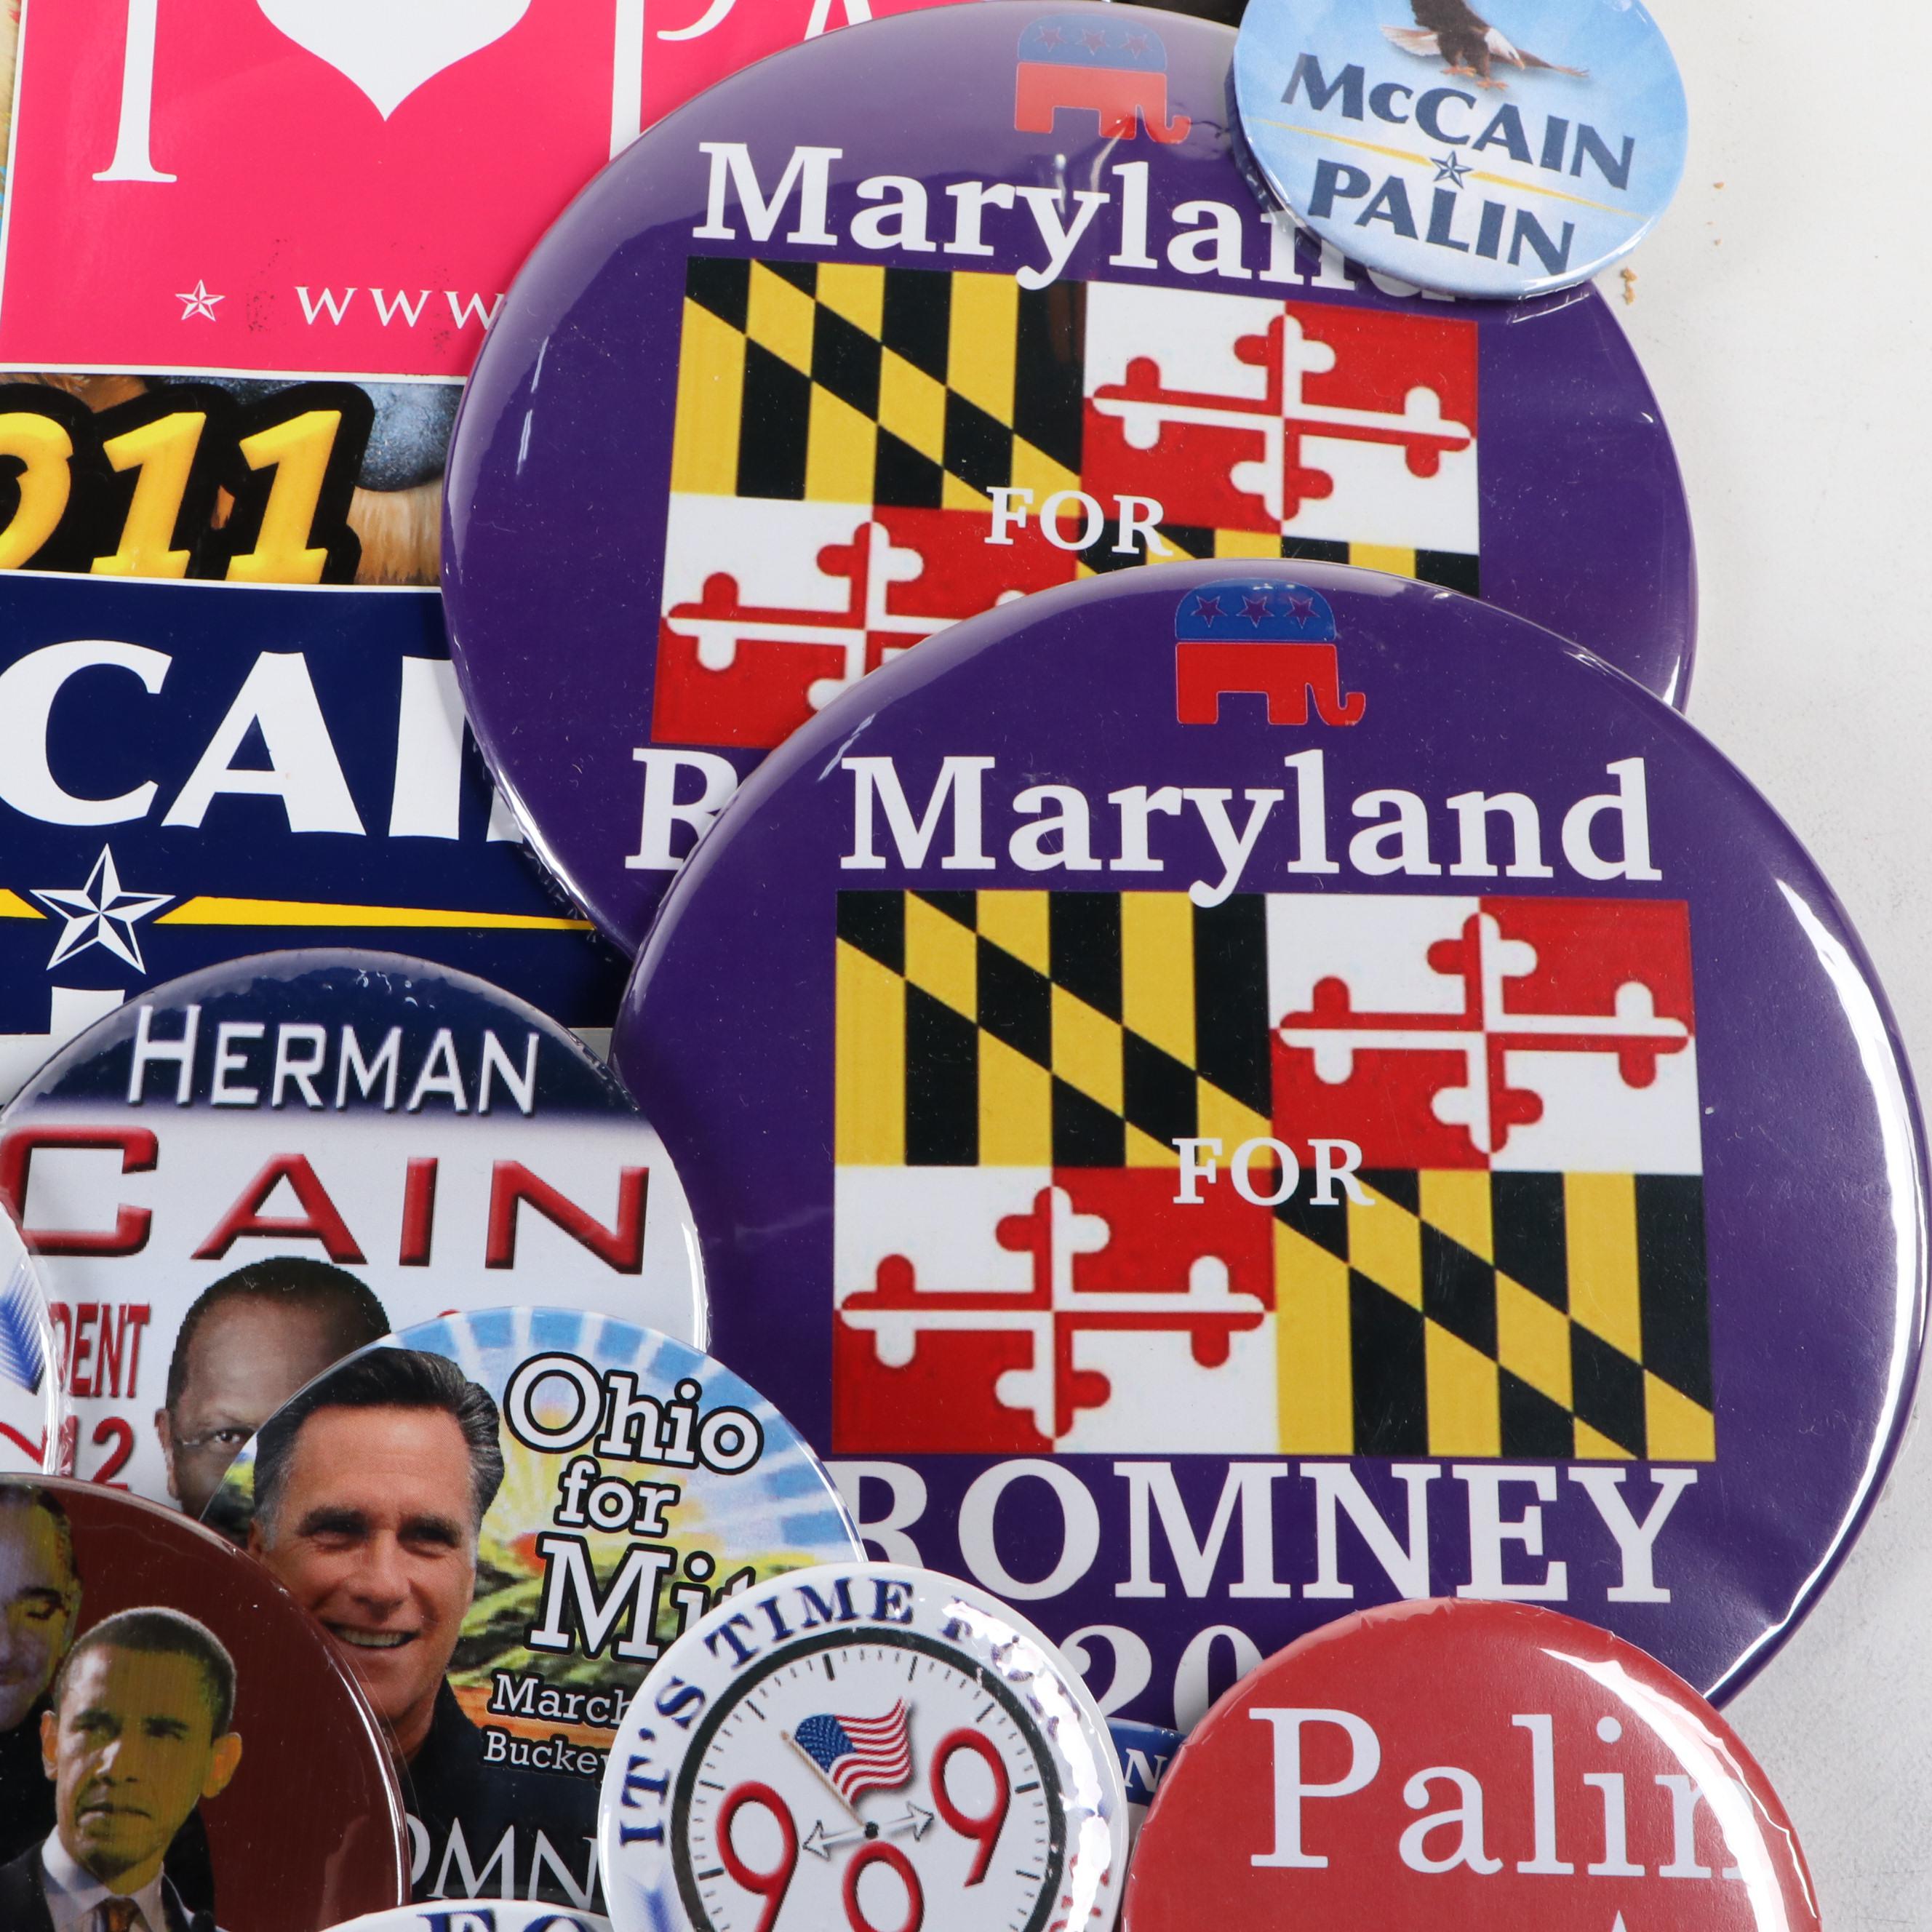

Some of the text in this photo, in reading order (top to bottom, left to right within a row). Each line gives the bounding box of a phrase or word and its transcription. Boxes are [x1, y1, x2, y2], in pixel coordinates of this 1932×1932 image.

[692, 142, 1457, 303] Marylan
[1307, 158, 1576, 276] PALIN
[983, 485, 1173, 556] FOR
[0, 639, 525, 843] CAI
[839, 749, 1664, 909] Maryland
[0, 1125, 650, 1276] CAIN
[1170, 1137, 1376, 1208] FOR
[507, 1354, 761, 1472] Ohio
[556, 1458, 677, 1536] for
[824, 1458, 1699, 1605] ROMNEY
[529, 1536, 754, 1661] Mi
[703, 1577, 915, 1669] TIME
[618, 1674, 707, 1849] IT'S
[930, 1727, 1012, 1888] 9
